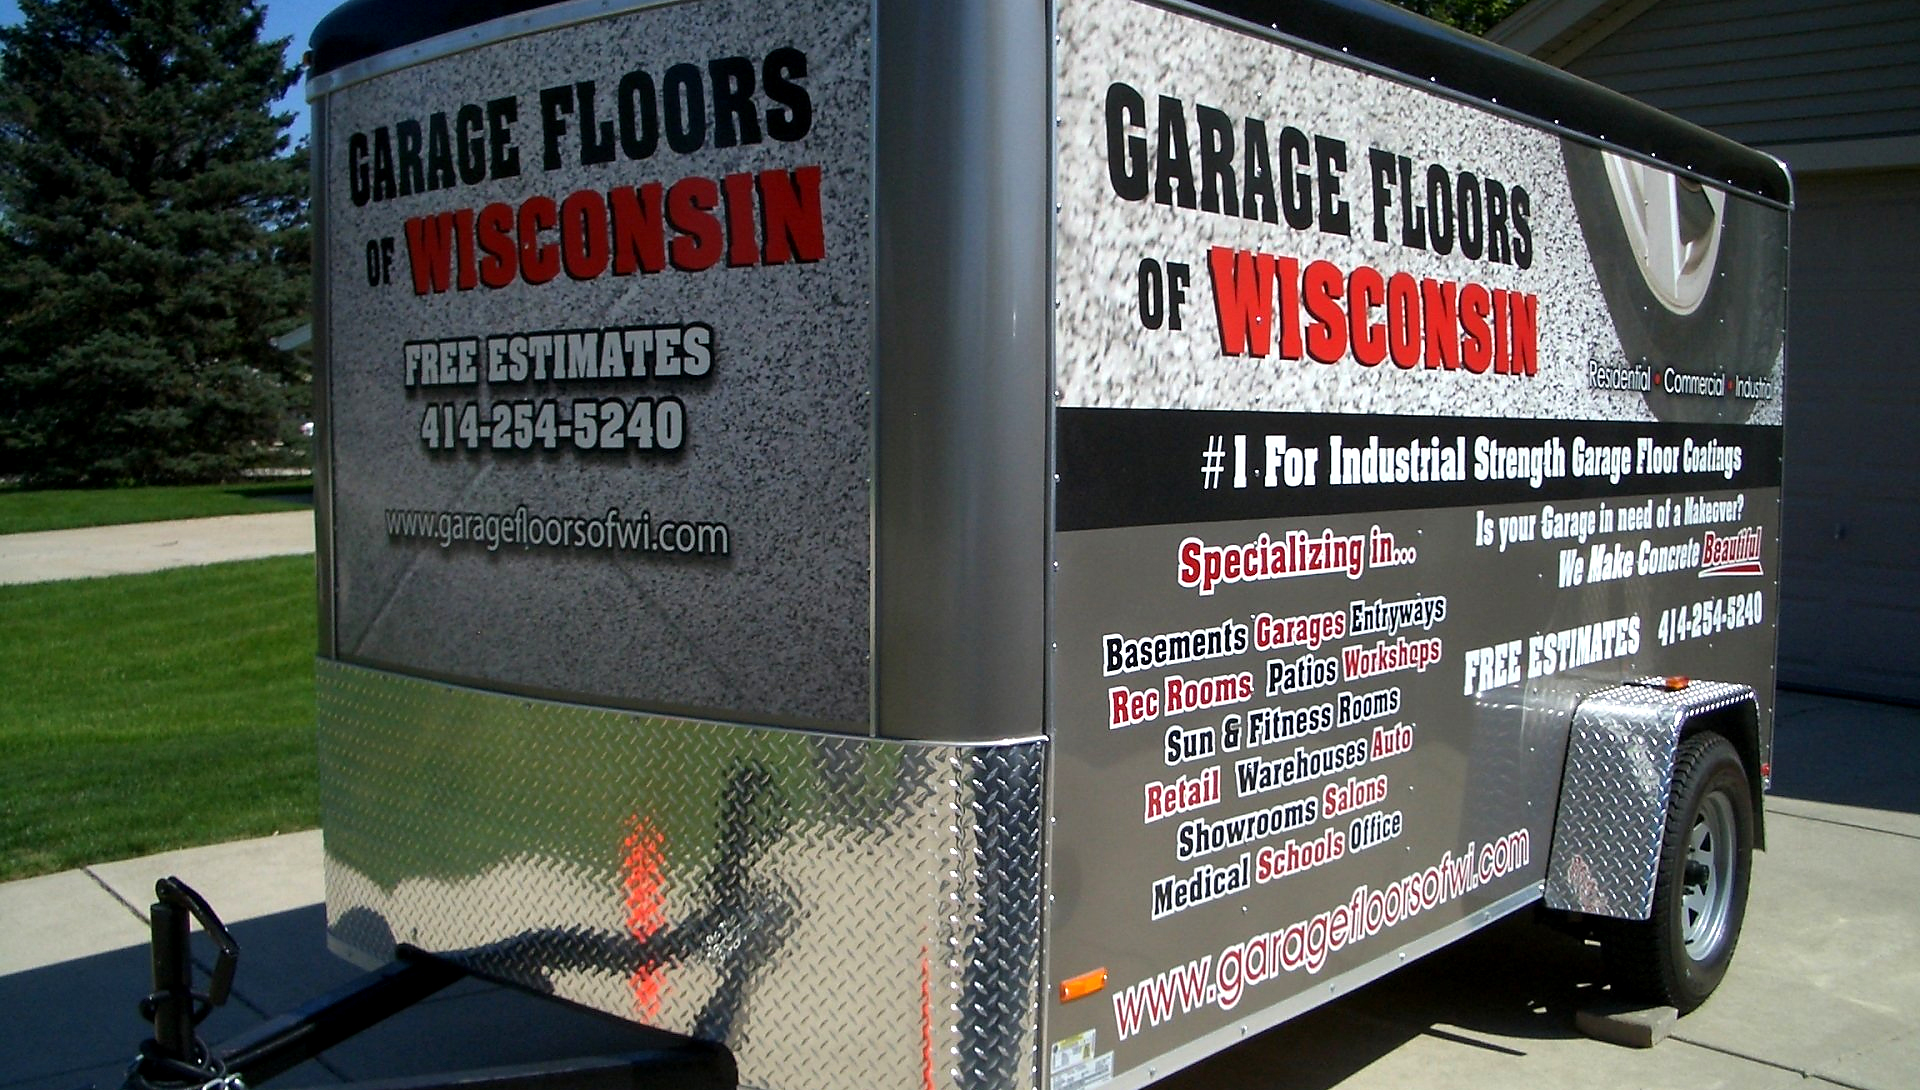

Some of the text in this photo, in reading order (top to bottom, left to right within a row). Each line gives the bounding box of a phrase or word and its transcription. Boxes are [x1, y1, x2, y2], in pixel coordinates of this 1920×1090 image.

[349, 47, 812, 207] GARAGE FLOORS
[1104, 82, 1533, 269] GARAGE FLOORS
[366, 165, 825, 295] OF WISCONSIN
[1138, 246, 1538, 376] OF WISCONSIN
[404, 326, 713, 387] FREE ESTIMATES
[1589, 361, 1650, 391] Residential
[1664, 368, 1724, 396] Commercial
[420, 399, 685, 451] 414-254-5240
[1264, 435, 1318, 487] For
[1329, 435, 1465, 484] Industrial
[1474, 436, 1565, 488] Strength
[1572, 436, 1631, 484] Garage
[1636, 438, 1680, 474] Floor
[1683, 437, 1742, 480] Coatings
[385, 506, 729, 554] www.garagefloorsofwi.com
[1179, 524, 1417, 594] Specializing in...
[1476, 494, 1744, 552] Is your Garage in need of a Makeover?
[1559, 526, 1763, 588] We Make Concrete Beautiful
[1103, 594, 1447, 676] Basements Garages Entryways
[1464, 590, 1763, 696] FREE ESTIMATES 414-254-5240
[1109, 635, 1442, 730] Rec Rooms Patios Workshops
[1165, 688, 1401, 768] Sun & Fitness Rooms
[1144, 724, 1413, 824] Retail Warehouses Auto
[1177, 775, 1388, 862] Showrooms Salons
[1151, 811, 1403, 920] Medical Schools Office
[1113, 828, 1531, 1040] www.garagefloorsofwi.com
